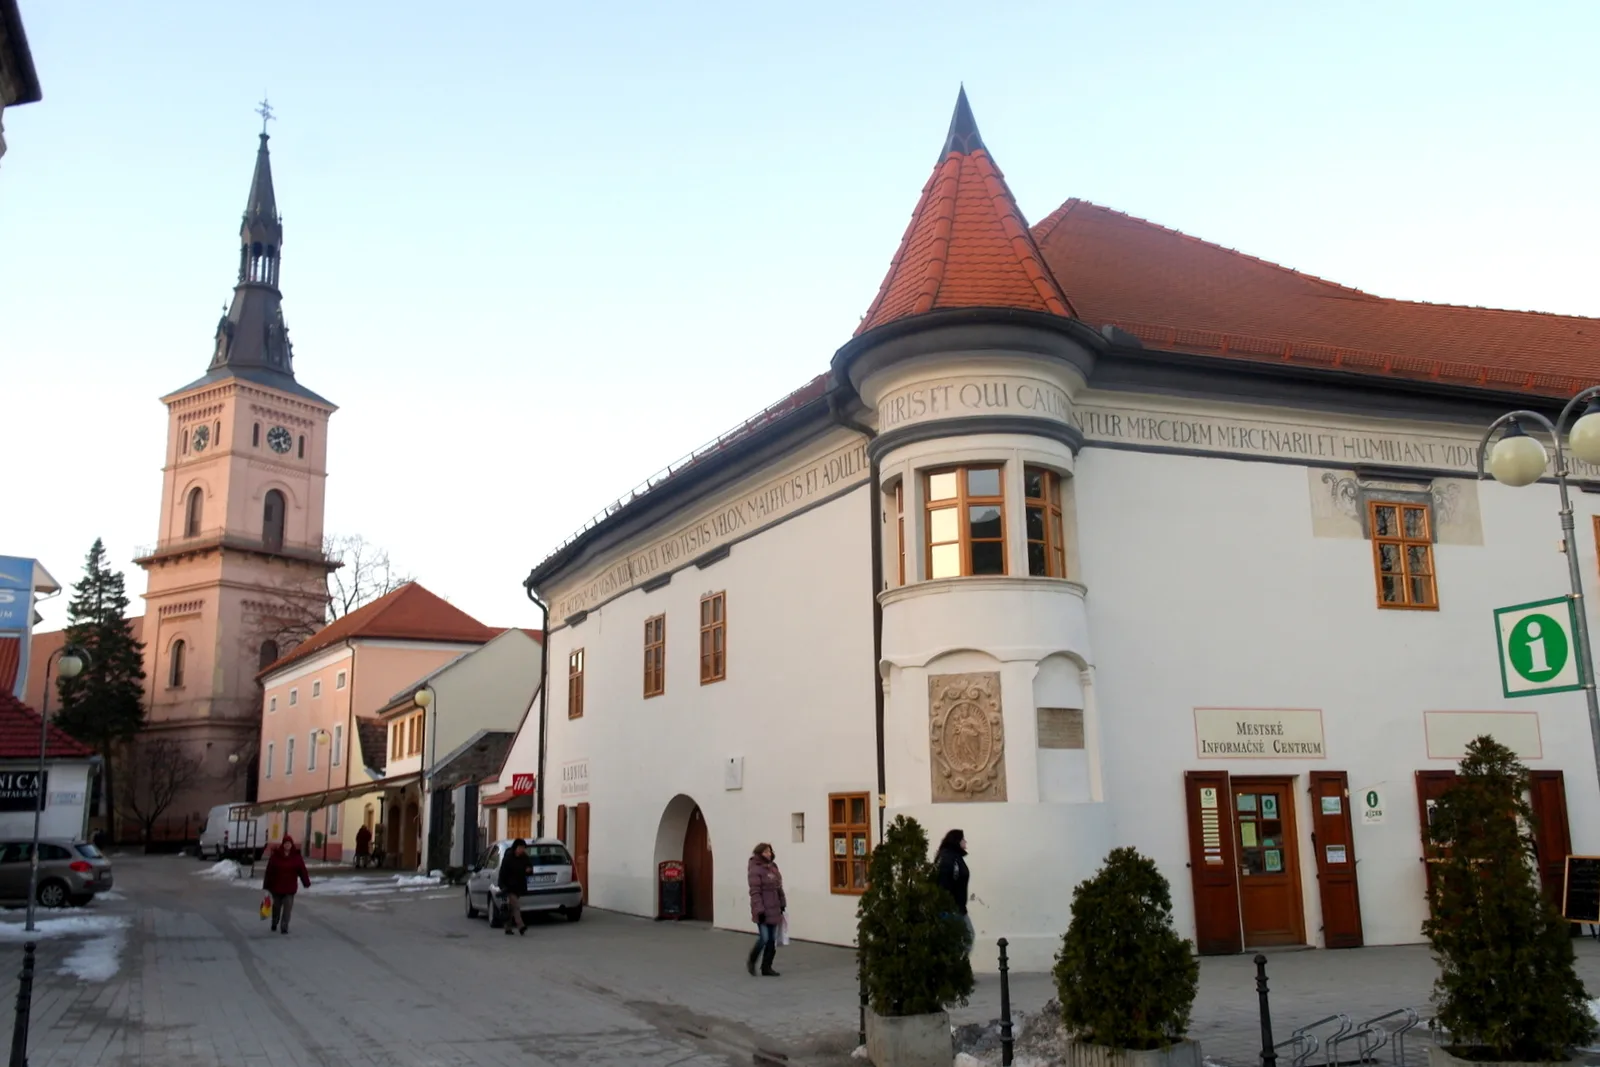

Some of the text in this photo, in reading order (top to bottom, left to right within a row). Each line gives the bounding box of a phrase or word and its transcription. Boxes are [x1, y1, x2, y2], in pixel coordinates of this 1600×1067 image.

[930, 384, 954, 414] ET
[959, 383, 1009, 408] QUI
[1126, 415, 1212, 446] MERCEDEM
[1342, 436, 1435, 463] HUMILIANT
[660, 539, 680, 565] ERO
[680, 522, 711, 556] TESTIS
[711, 503, 747, 537] VELOX
[747, 476, 803, 522] MALEFICIS
[805, 467, 818, 495] ET
[1273, 740, 1322, 753] CENTRUM
[513, 776, 533, 793] illy
